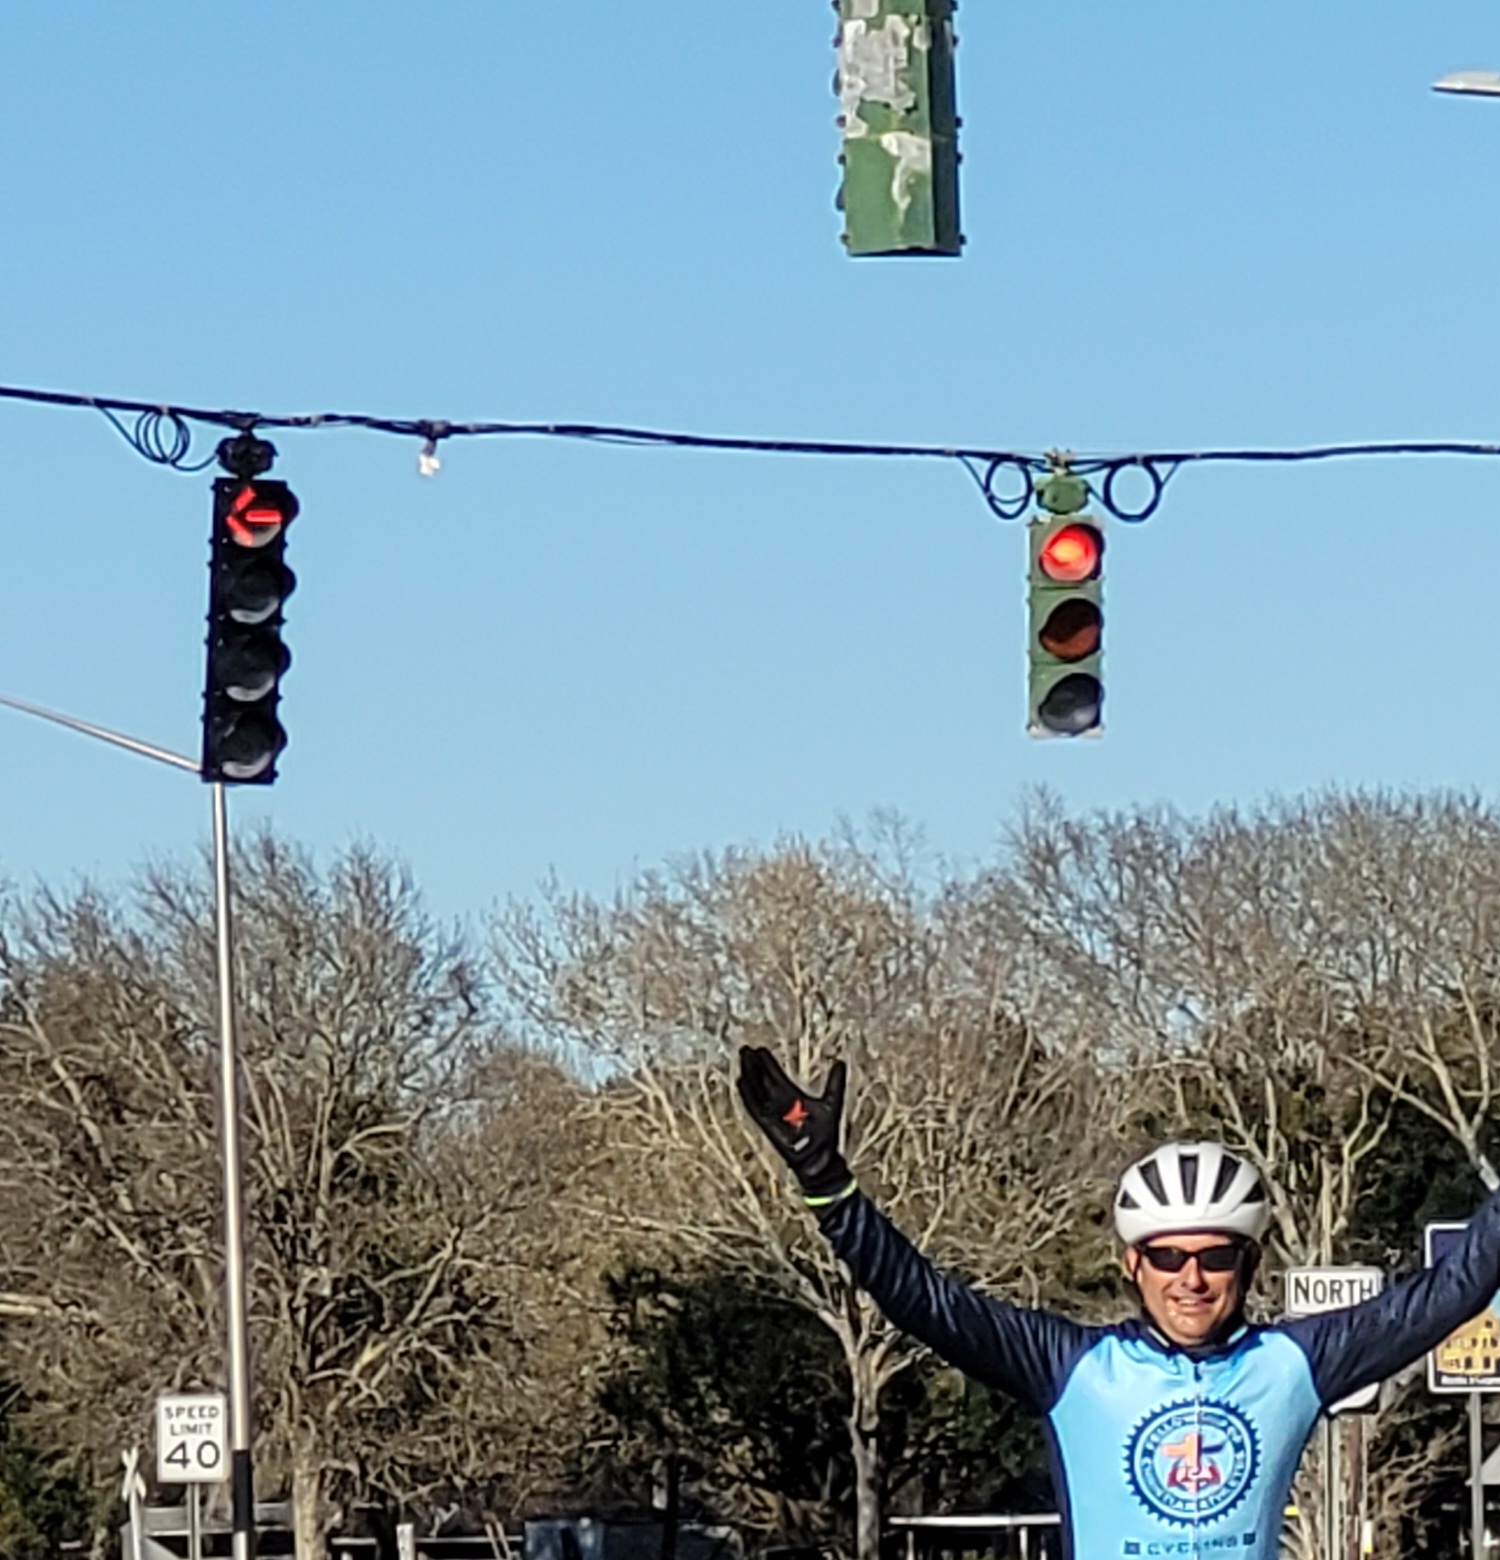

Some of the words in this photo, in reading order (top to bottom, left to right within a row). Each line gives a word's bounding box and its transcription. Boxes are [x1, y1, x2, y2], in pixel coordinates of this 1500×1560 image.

[1294, 1275, 1373, 1305] NORTH
[164, 1405, 219, 1419] SPEED
[170, 1423, 212, 1436] LIMIT
[164, 1440, 220, 1469] 40
